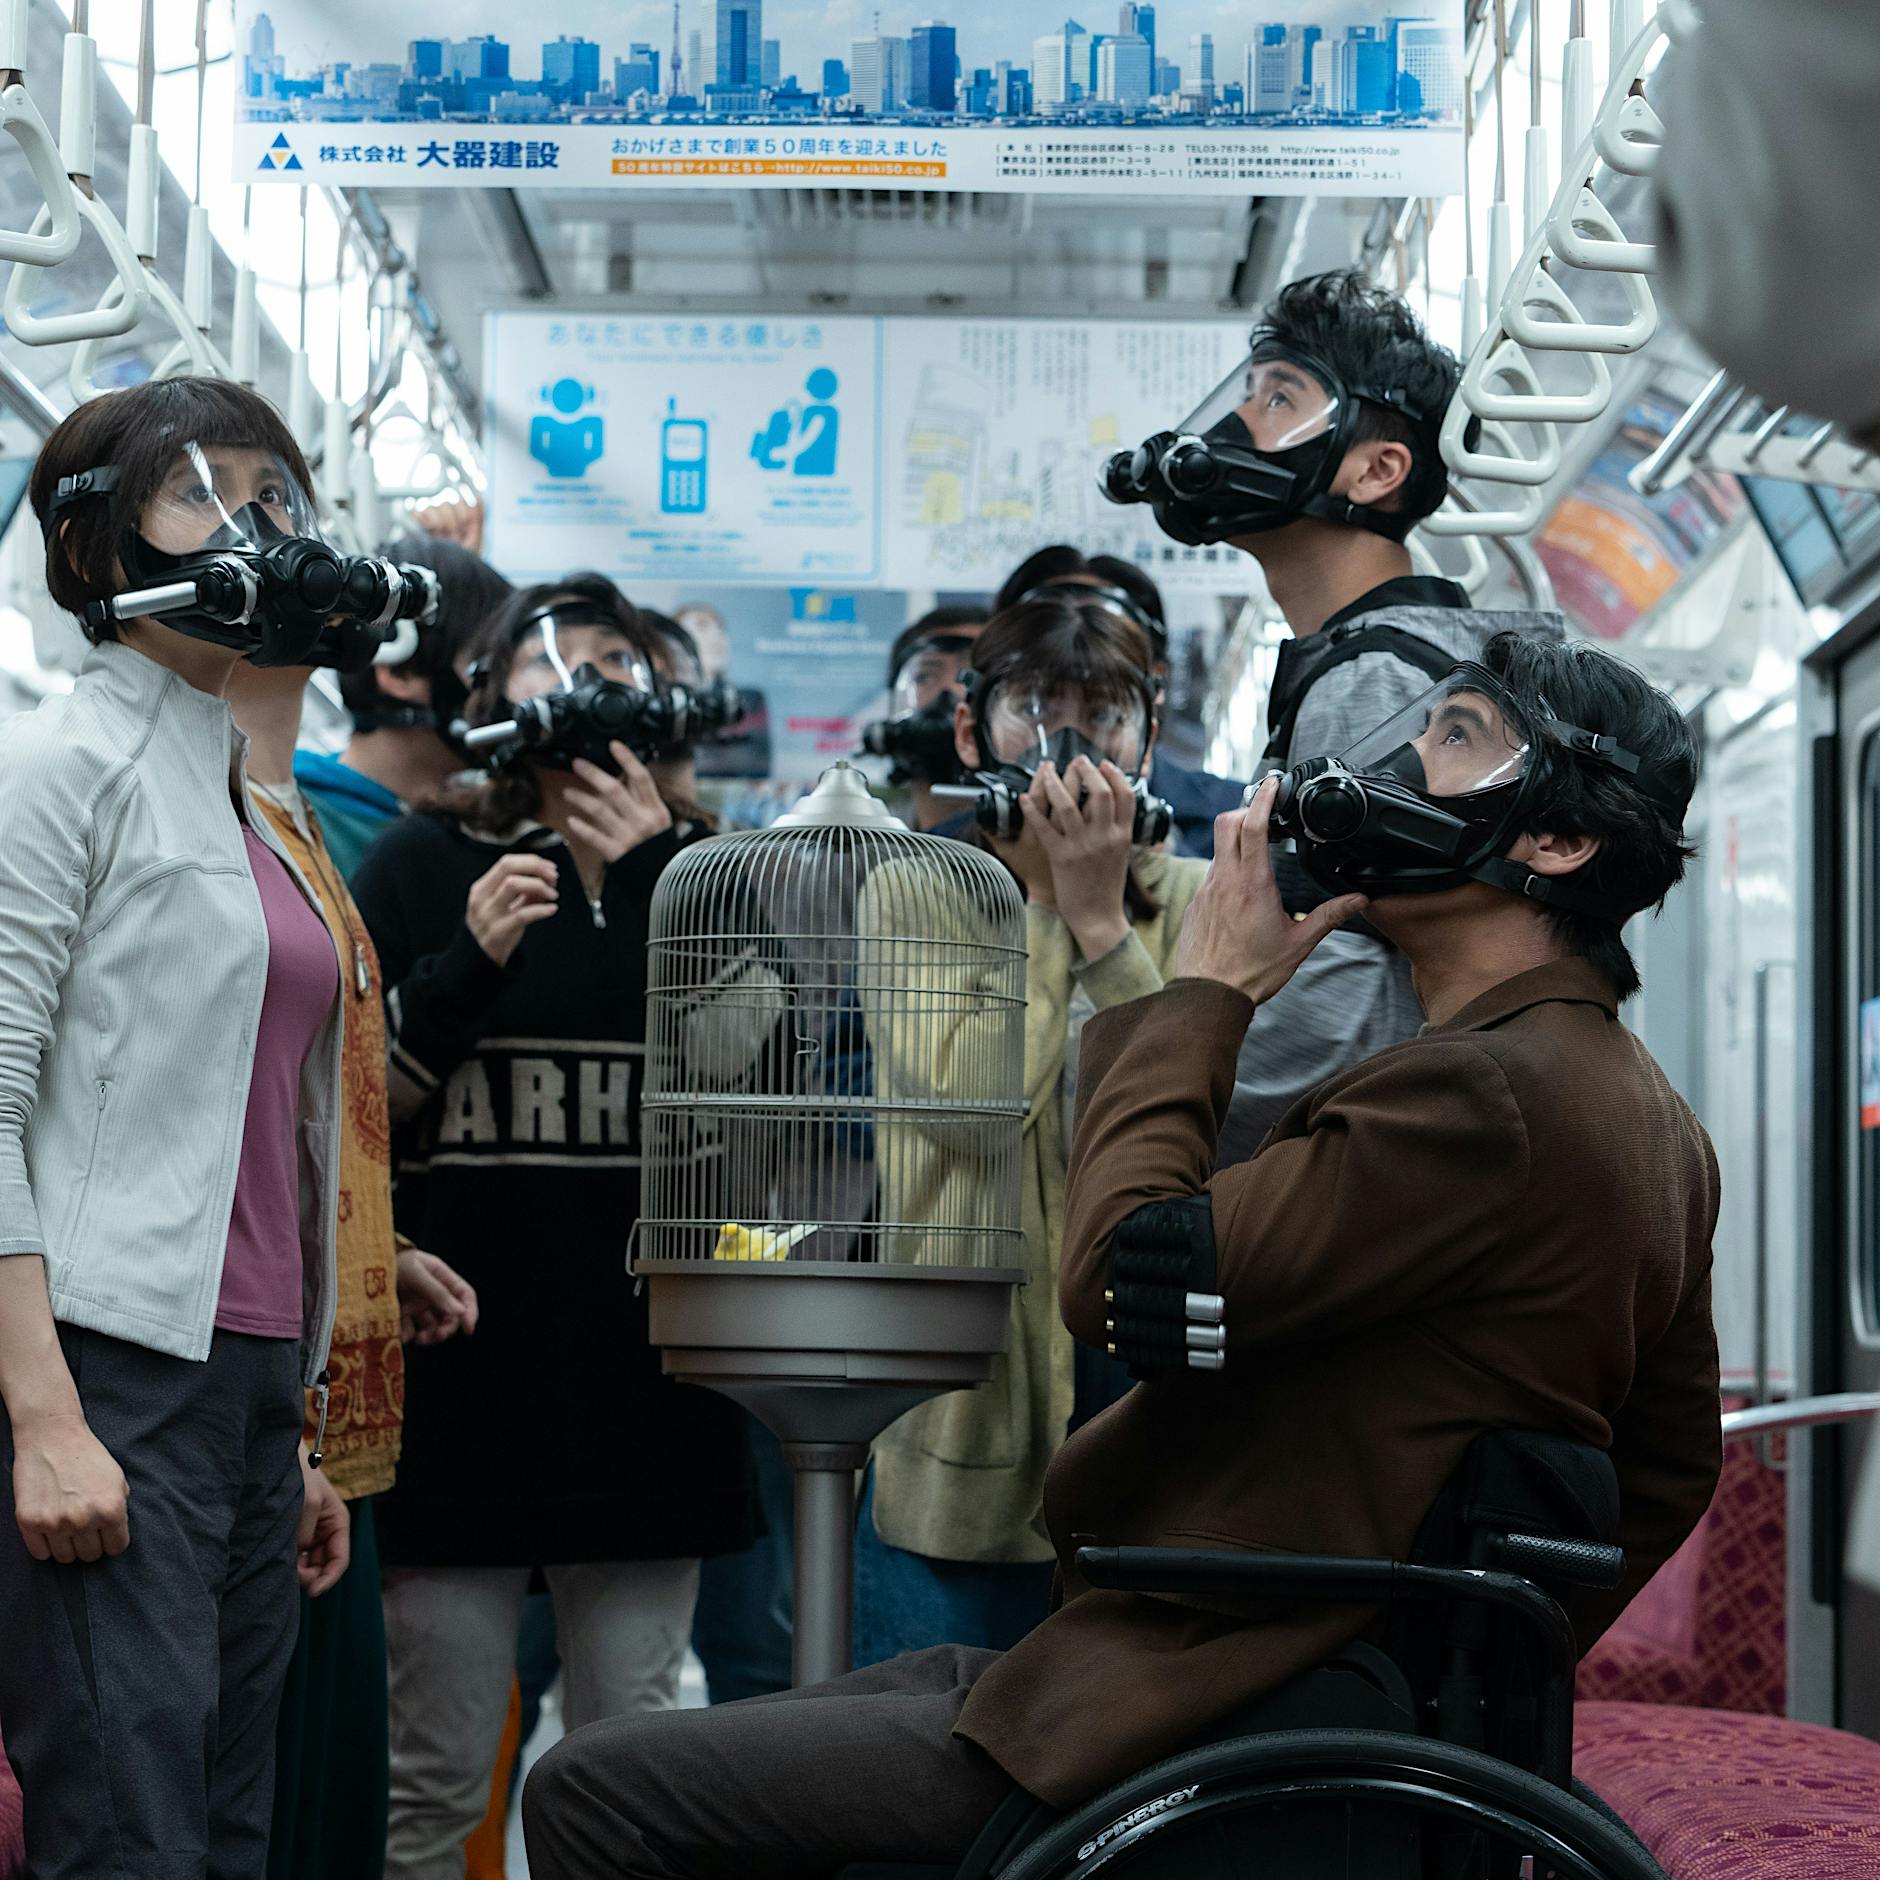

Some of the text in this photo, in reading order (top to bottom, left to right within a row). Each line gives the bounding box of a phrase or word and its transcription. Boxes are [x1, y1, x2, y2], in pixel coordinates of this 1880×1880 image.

[319, 140, 561, 170] 株式会社 大器建設
[611, 137, 948, 159] おかげさまで創業50周年を迎えました
[550, 322, 823, 349] あなたにできる優しさ
[1077, 1784, 1200, 1861] SPINERGY
